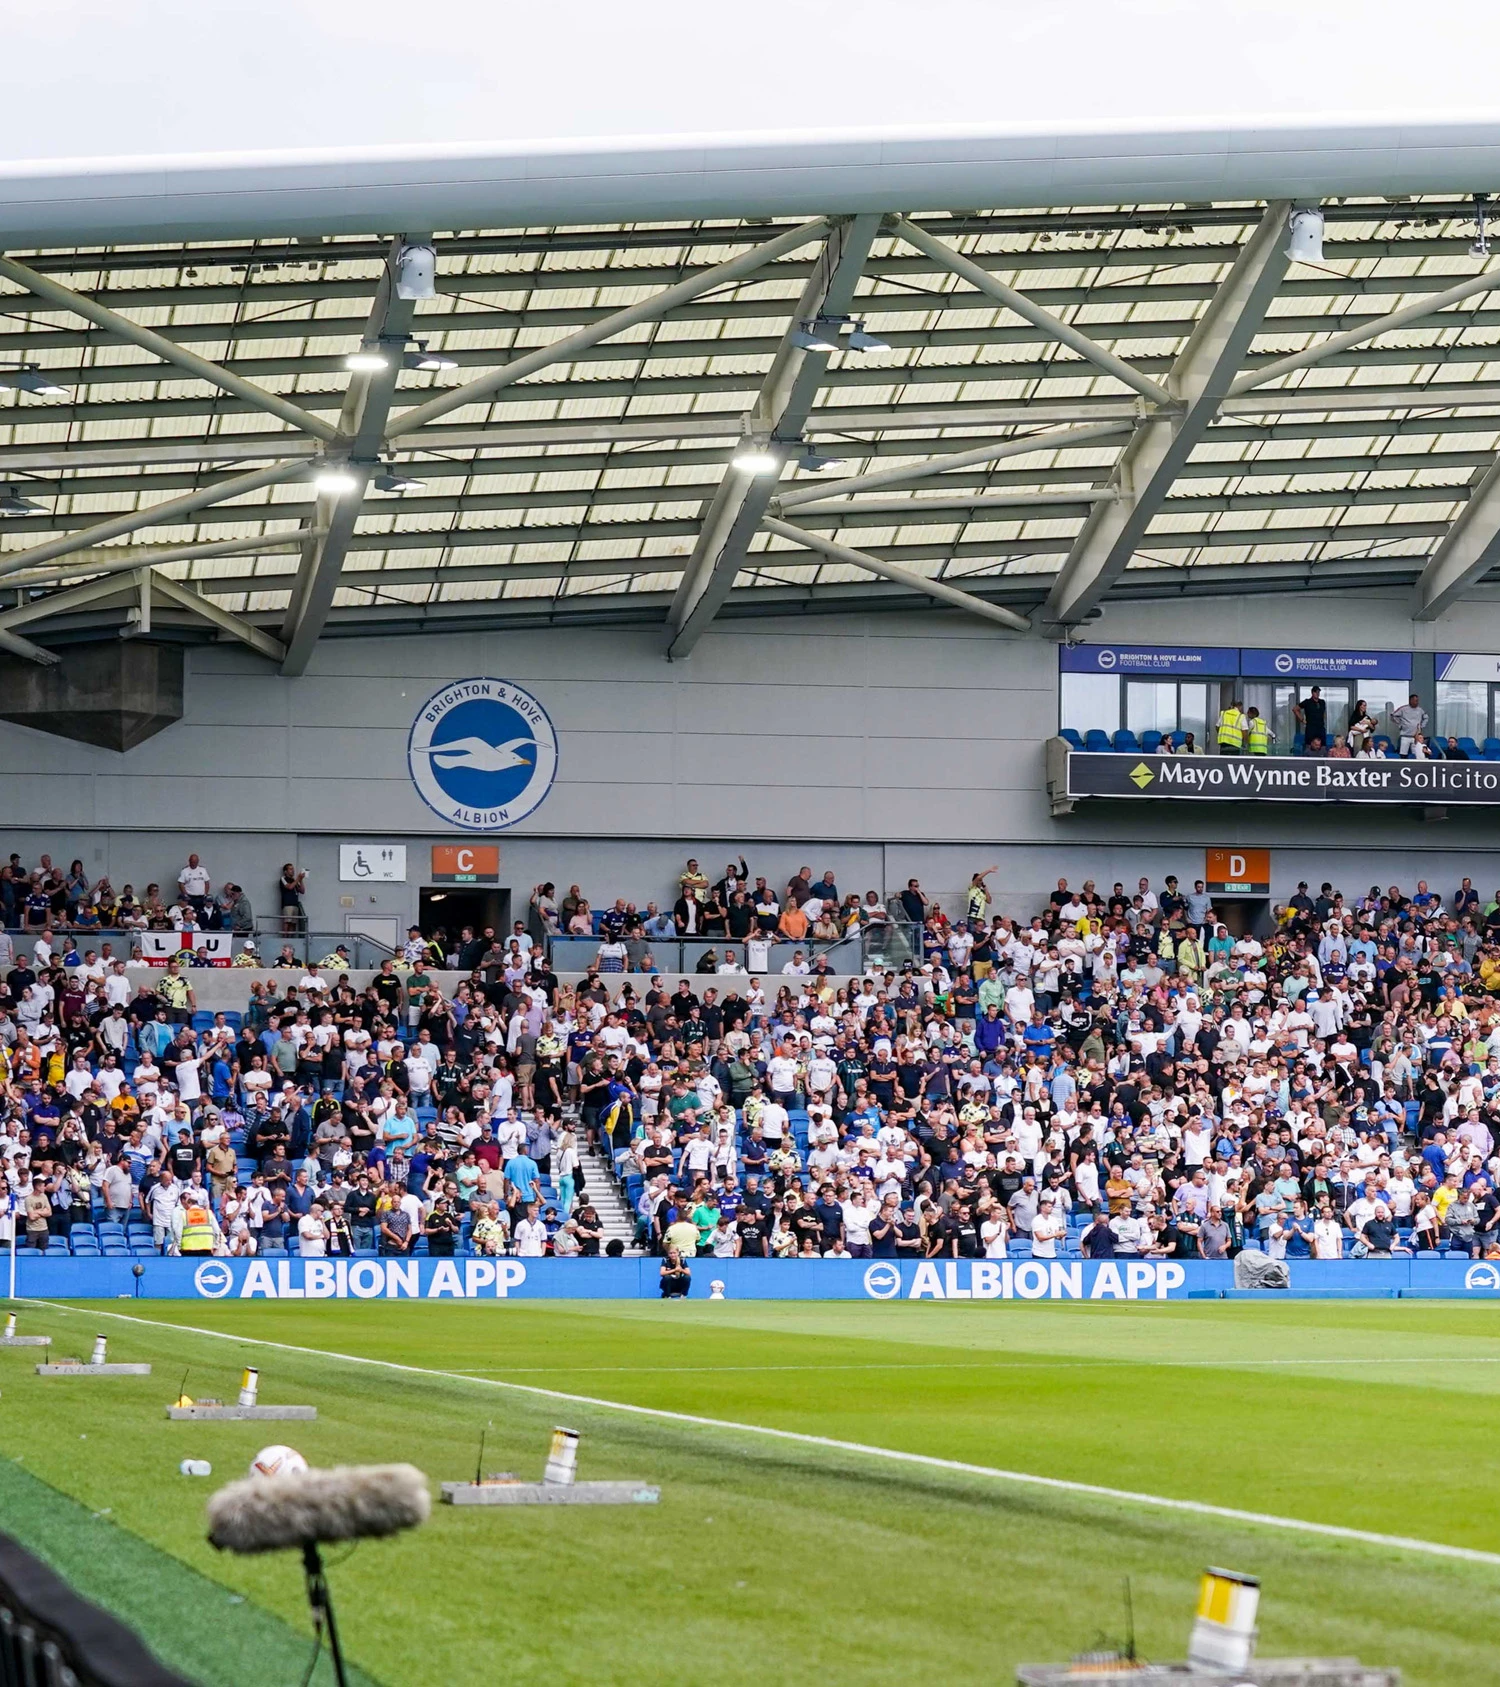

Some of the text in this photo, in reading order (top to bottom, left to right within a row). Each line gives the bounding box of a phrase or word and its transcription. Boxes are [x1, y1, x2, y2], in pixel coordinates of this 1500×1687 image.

[425, 684, 543, 725] BRIGHTON & HOVE
[1159, 762, 1224, 791] Mayo
[1228, 764, 1310, 792] Wynne
[1316, 765, 1391, 787] Baxter
[453, 808, 509, 824] ALBION
[458, 849, 474, 872] C
[1230, 855, 1246, 877] D
[155, 939, 219, 951] L U
[240, 1260, 526, 1298] ALBION APP
[908, 1262, 1185, 1299] ALBION APP
